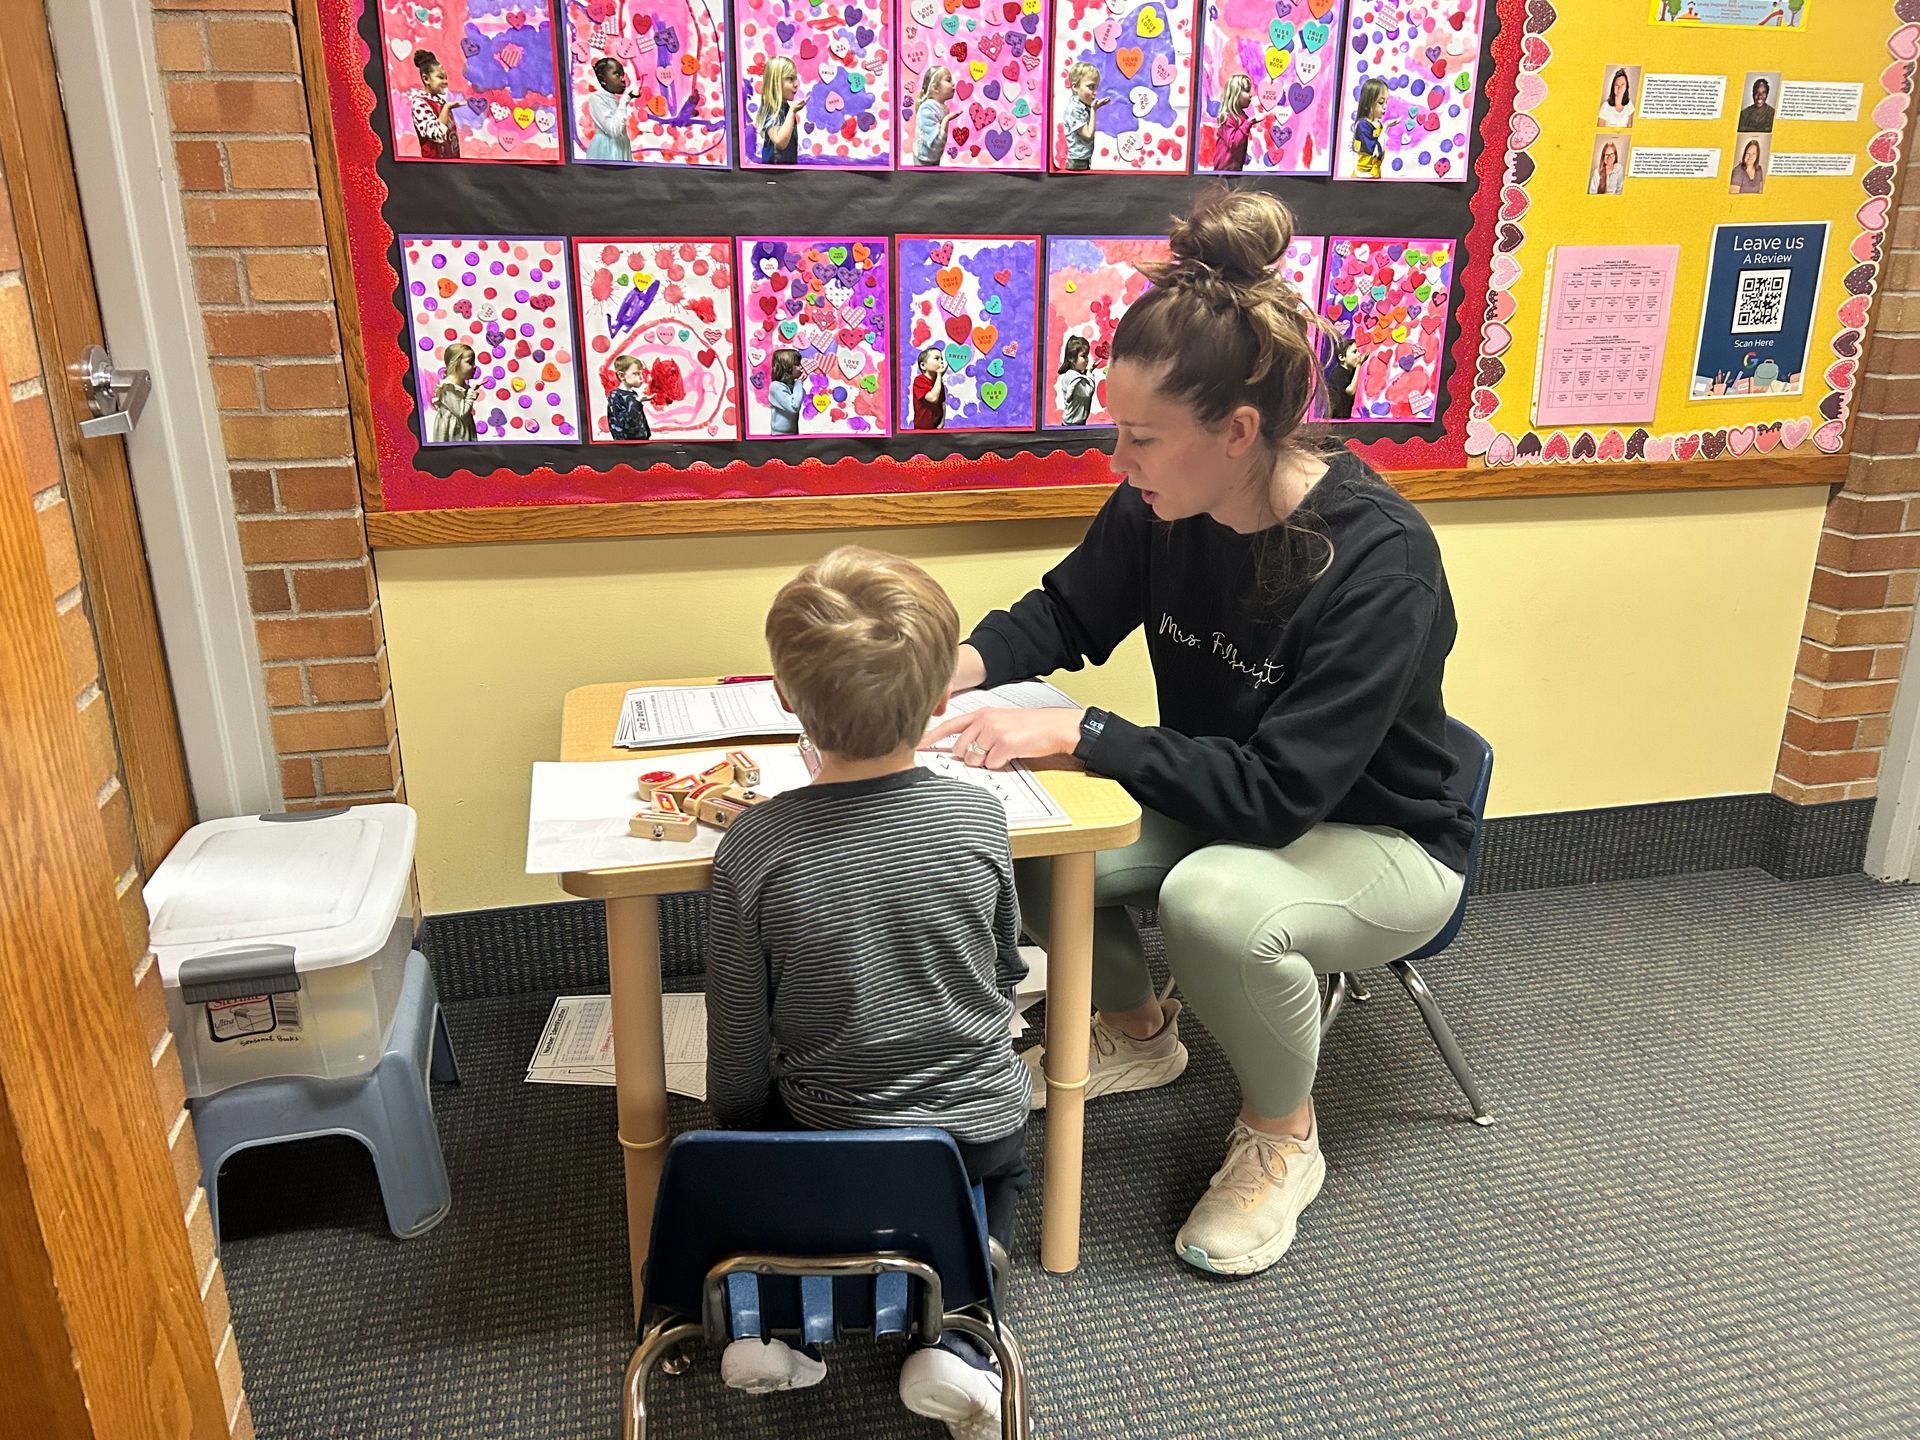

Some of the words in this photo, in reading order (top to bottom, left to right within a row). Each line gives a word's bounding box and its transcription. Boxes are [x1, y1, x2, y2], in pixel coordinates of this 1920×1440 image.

[918, 4, 934, 15] LOVE
[922, 10, 934, 20] BUG
[1140, 18, 1154, 34] LOVE
[1145, 15, 1156, 30] TRUE
[1102, 24, 1112, 46] SWEET
[1274, 28, 1290, 36] KISS
[1308, 30, 1324, 38] TRUE
[1306, 35, 1322, 44] LOVE
[1156, 70, 1166, 80] YOU
[1157, 64, 1170, 77] ONLY
[1734, 236, 1782, 251] Leave
[1786, 236, 1804, 250] us
[1743, 254, 1751, 264] A
[1754, 253, 1792, 264] Review
[1734, 339, 1753, 348] Scan
[1754, 339, 1774, 347] Here
[1159, 612, 1201, 648] Mrs.
